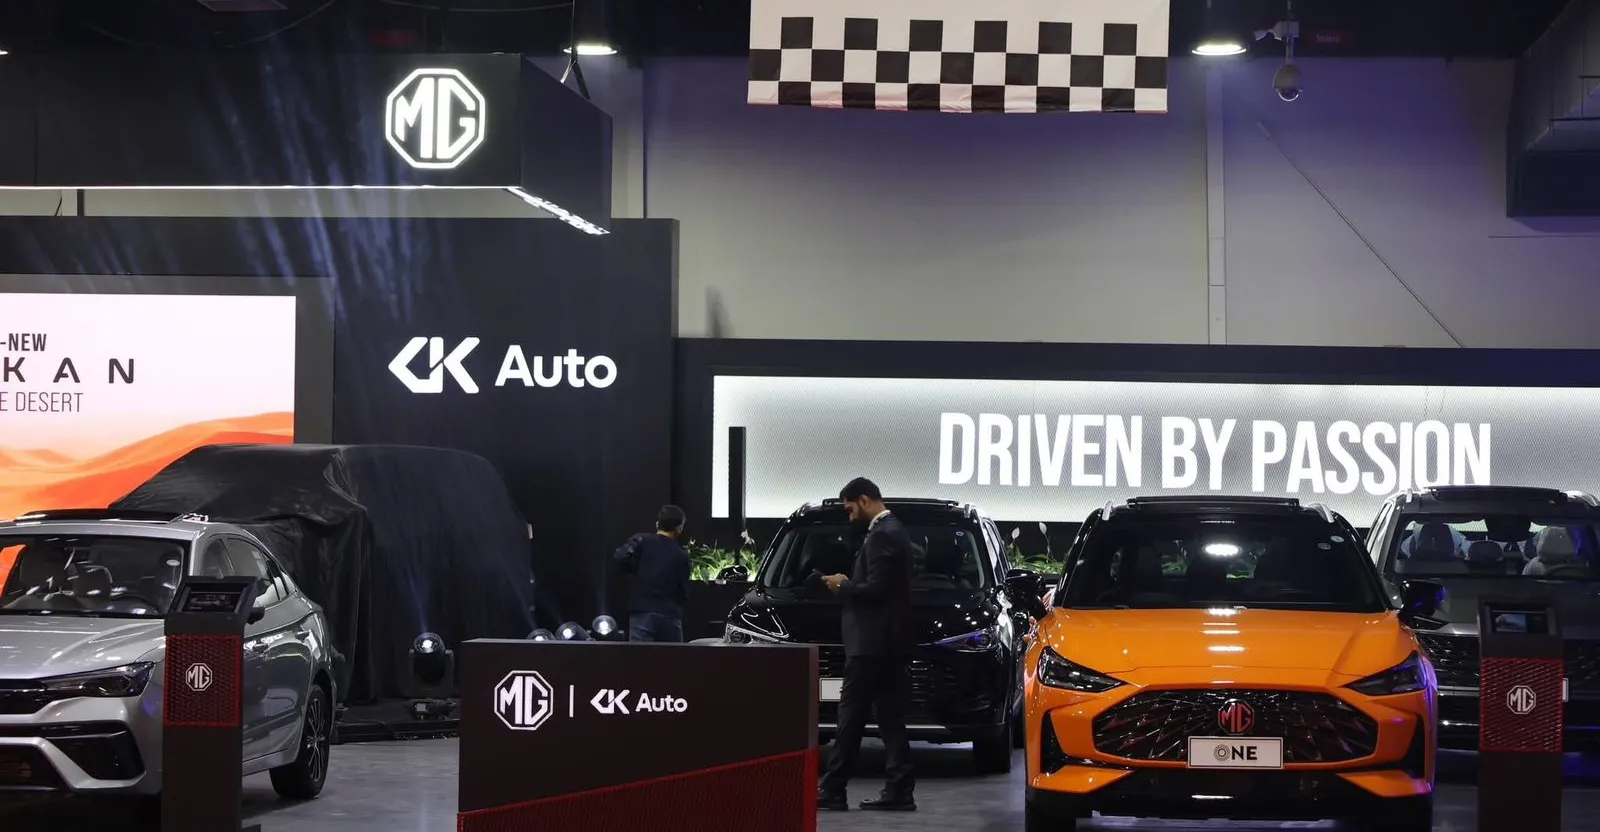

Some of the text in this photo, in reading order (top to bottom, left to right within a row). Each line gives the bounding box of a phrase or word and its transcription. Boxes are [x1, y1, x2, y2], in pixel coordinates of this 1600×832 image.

[394, 77, 476, 160] MG
[494, 344, 618, 389] Auto
[15, 391, 84, 413] DESERT
[938, 411, 1492, 496] DRIVEN BY PASSION
[187, 665, 210, 689] MG
[500, 675, 549, 726] MG
[635, 692, 688, 713] Auto
[1509, 688, 1535, 712] MG
[1221, 702, 1252, 733] MG
[1213, 744, 1258, 762] ONE
